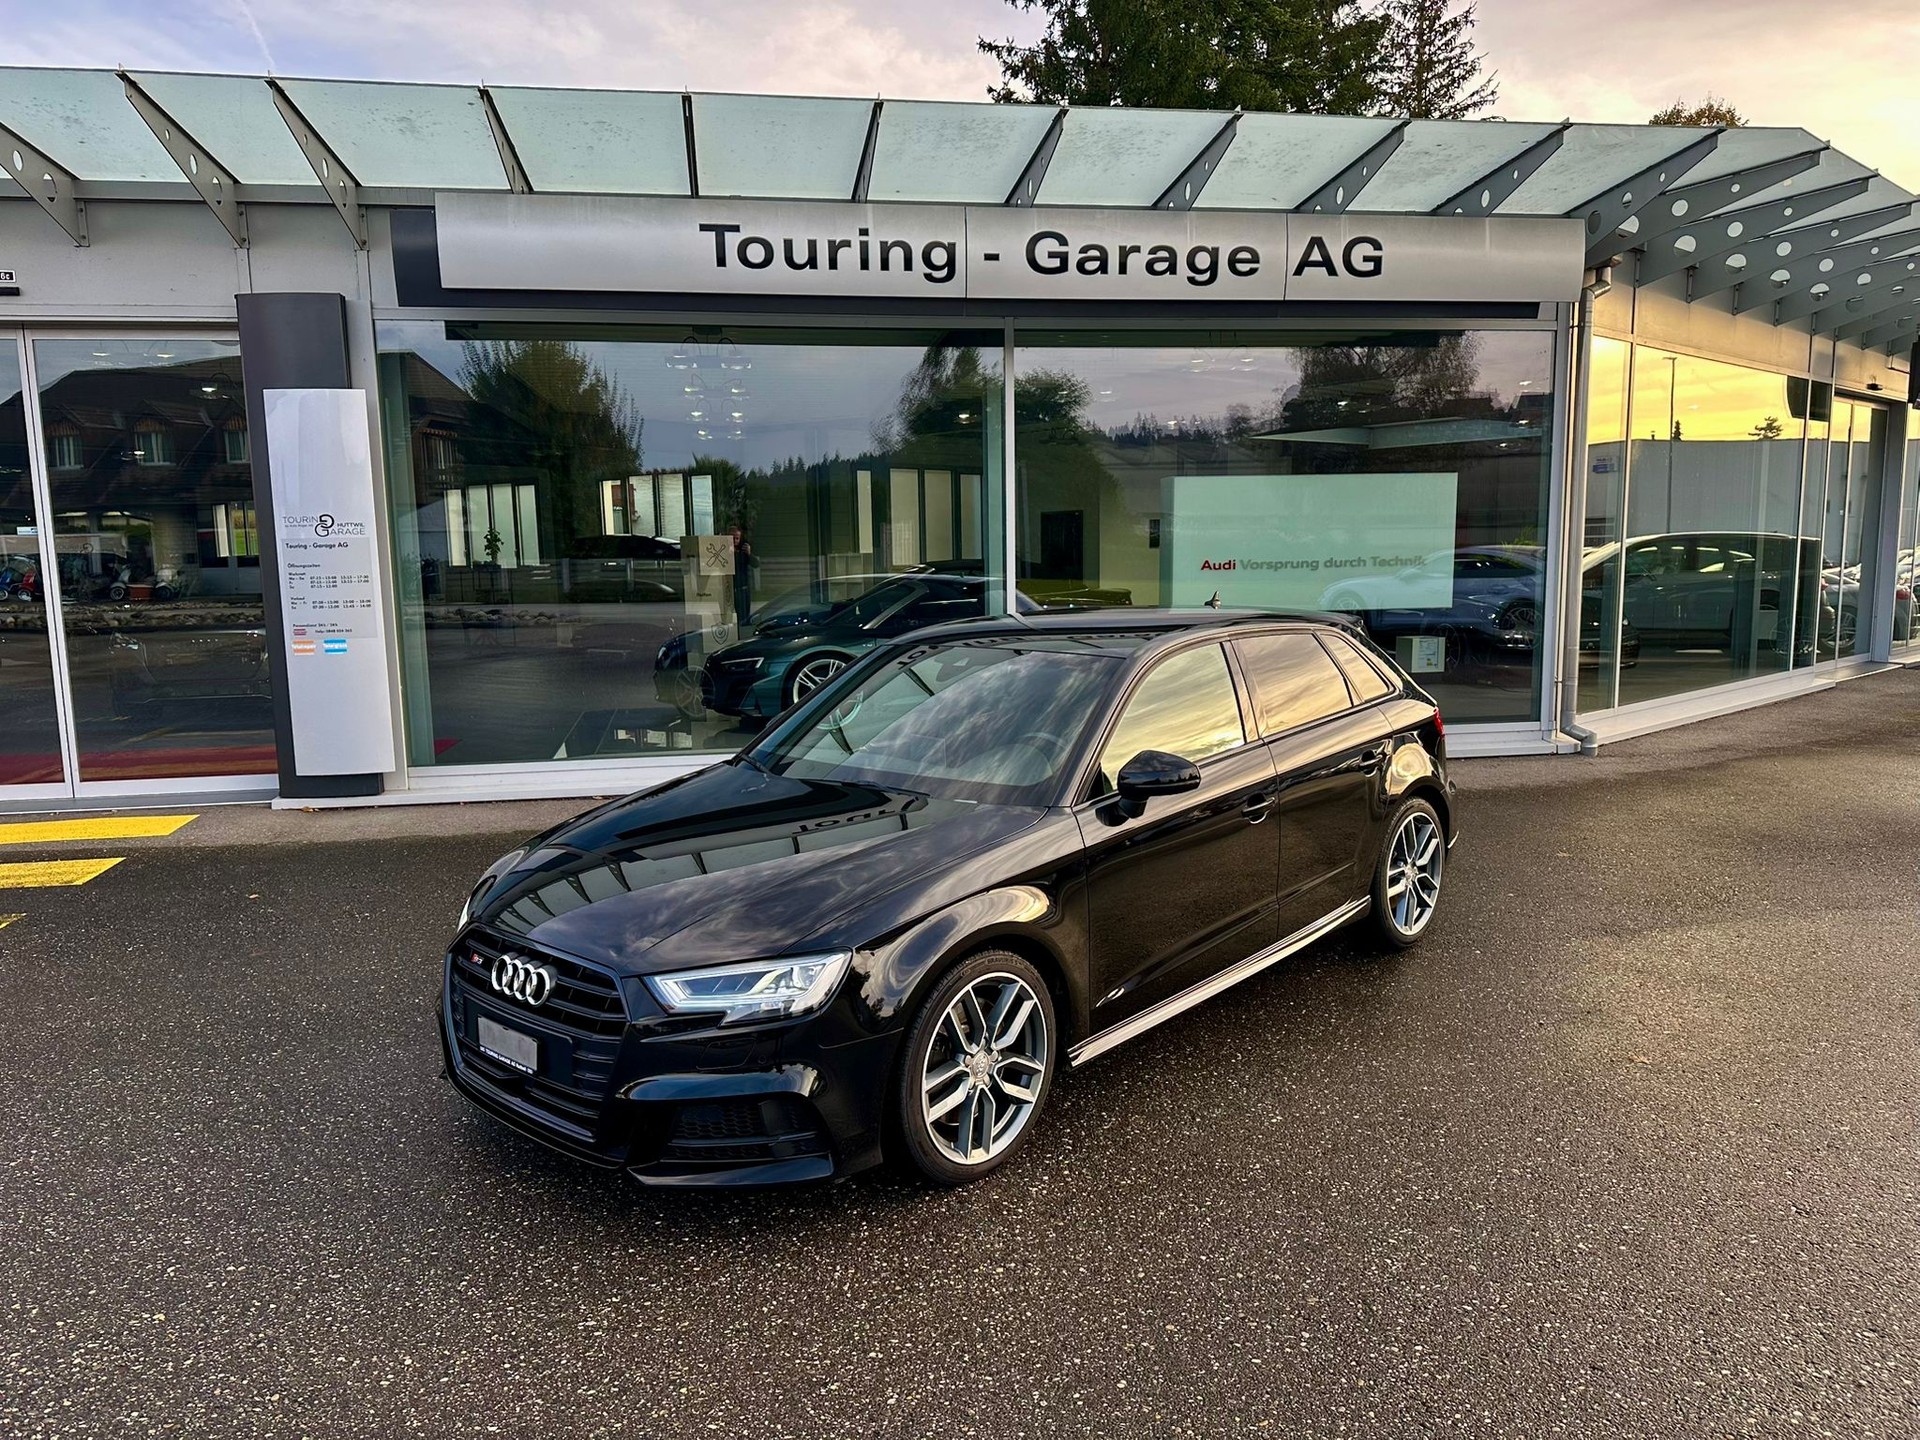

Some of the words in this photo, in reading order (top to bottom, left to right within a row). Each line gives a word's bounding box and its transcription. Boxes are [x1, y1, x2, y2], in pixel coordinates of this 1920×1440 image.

[698, 223, 957, 284] Touring
[983, 252, 1000, 262] -
[1025, 230, 1261, 287] Garage
[1292, 235, 1385, 279] AG
[285, 542, 308, 550] Touring
[312, 542, 336, 550] Garage
[1201, 559, 1237, 571] Audi
[1239, 557, 1320, 572] Vorsprung
[1323, 556, 1367, 570] durch
[1370, 555, 1428, 568] Technik
